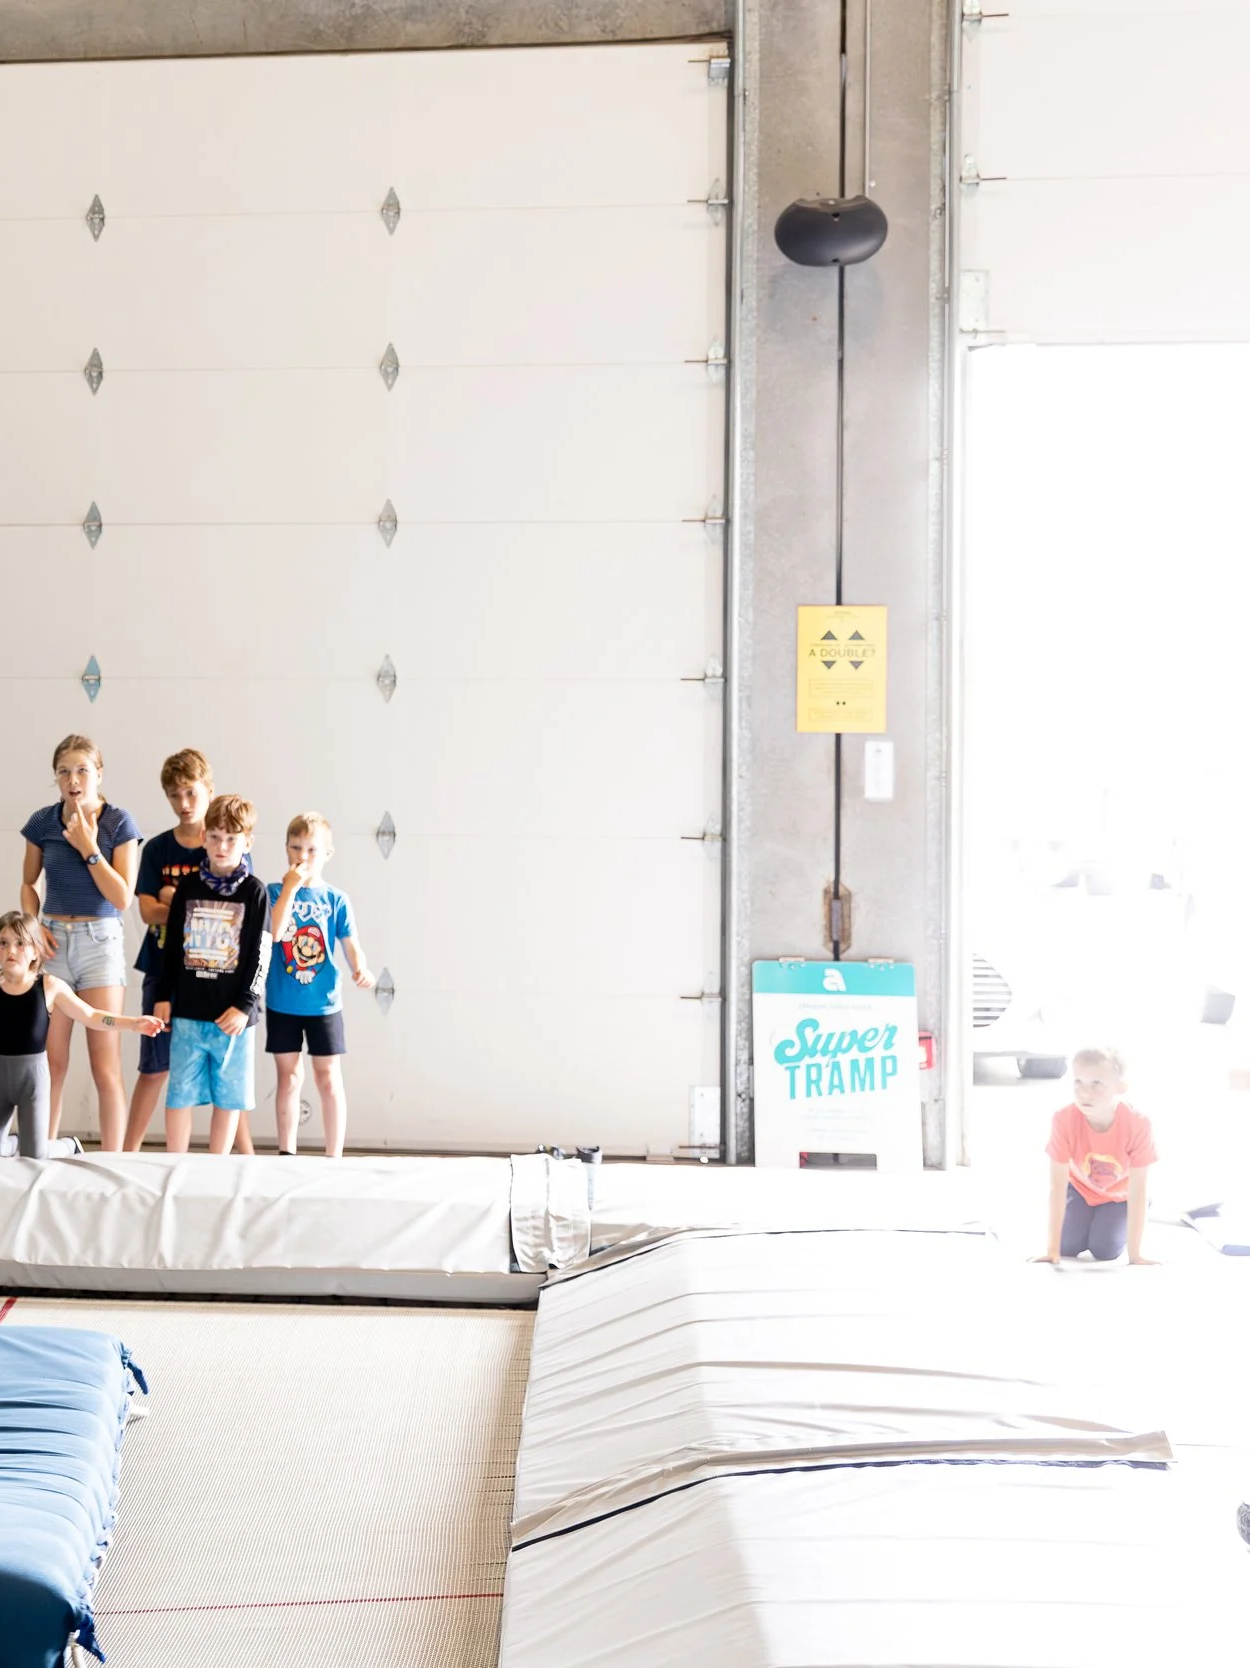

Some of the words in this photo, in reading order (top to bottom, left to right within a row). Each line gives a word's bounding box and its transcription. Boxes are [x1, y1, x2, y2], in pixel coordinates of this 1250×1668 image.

[808, 648, 817, 658] A
[774, 1018, 898, 1068] Super
[784, 1055, 898, 1100] TRAMP
